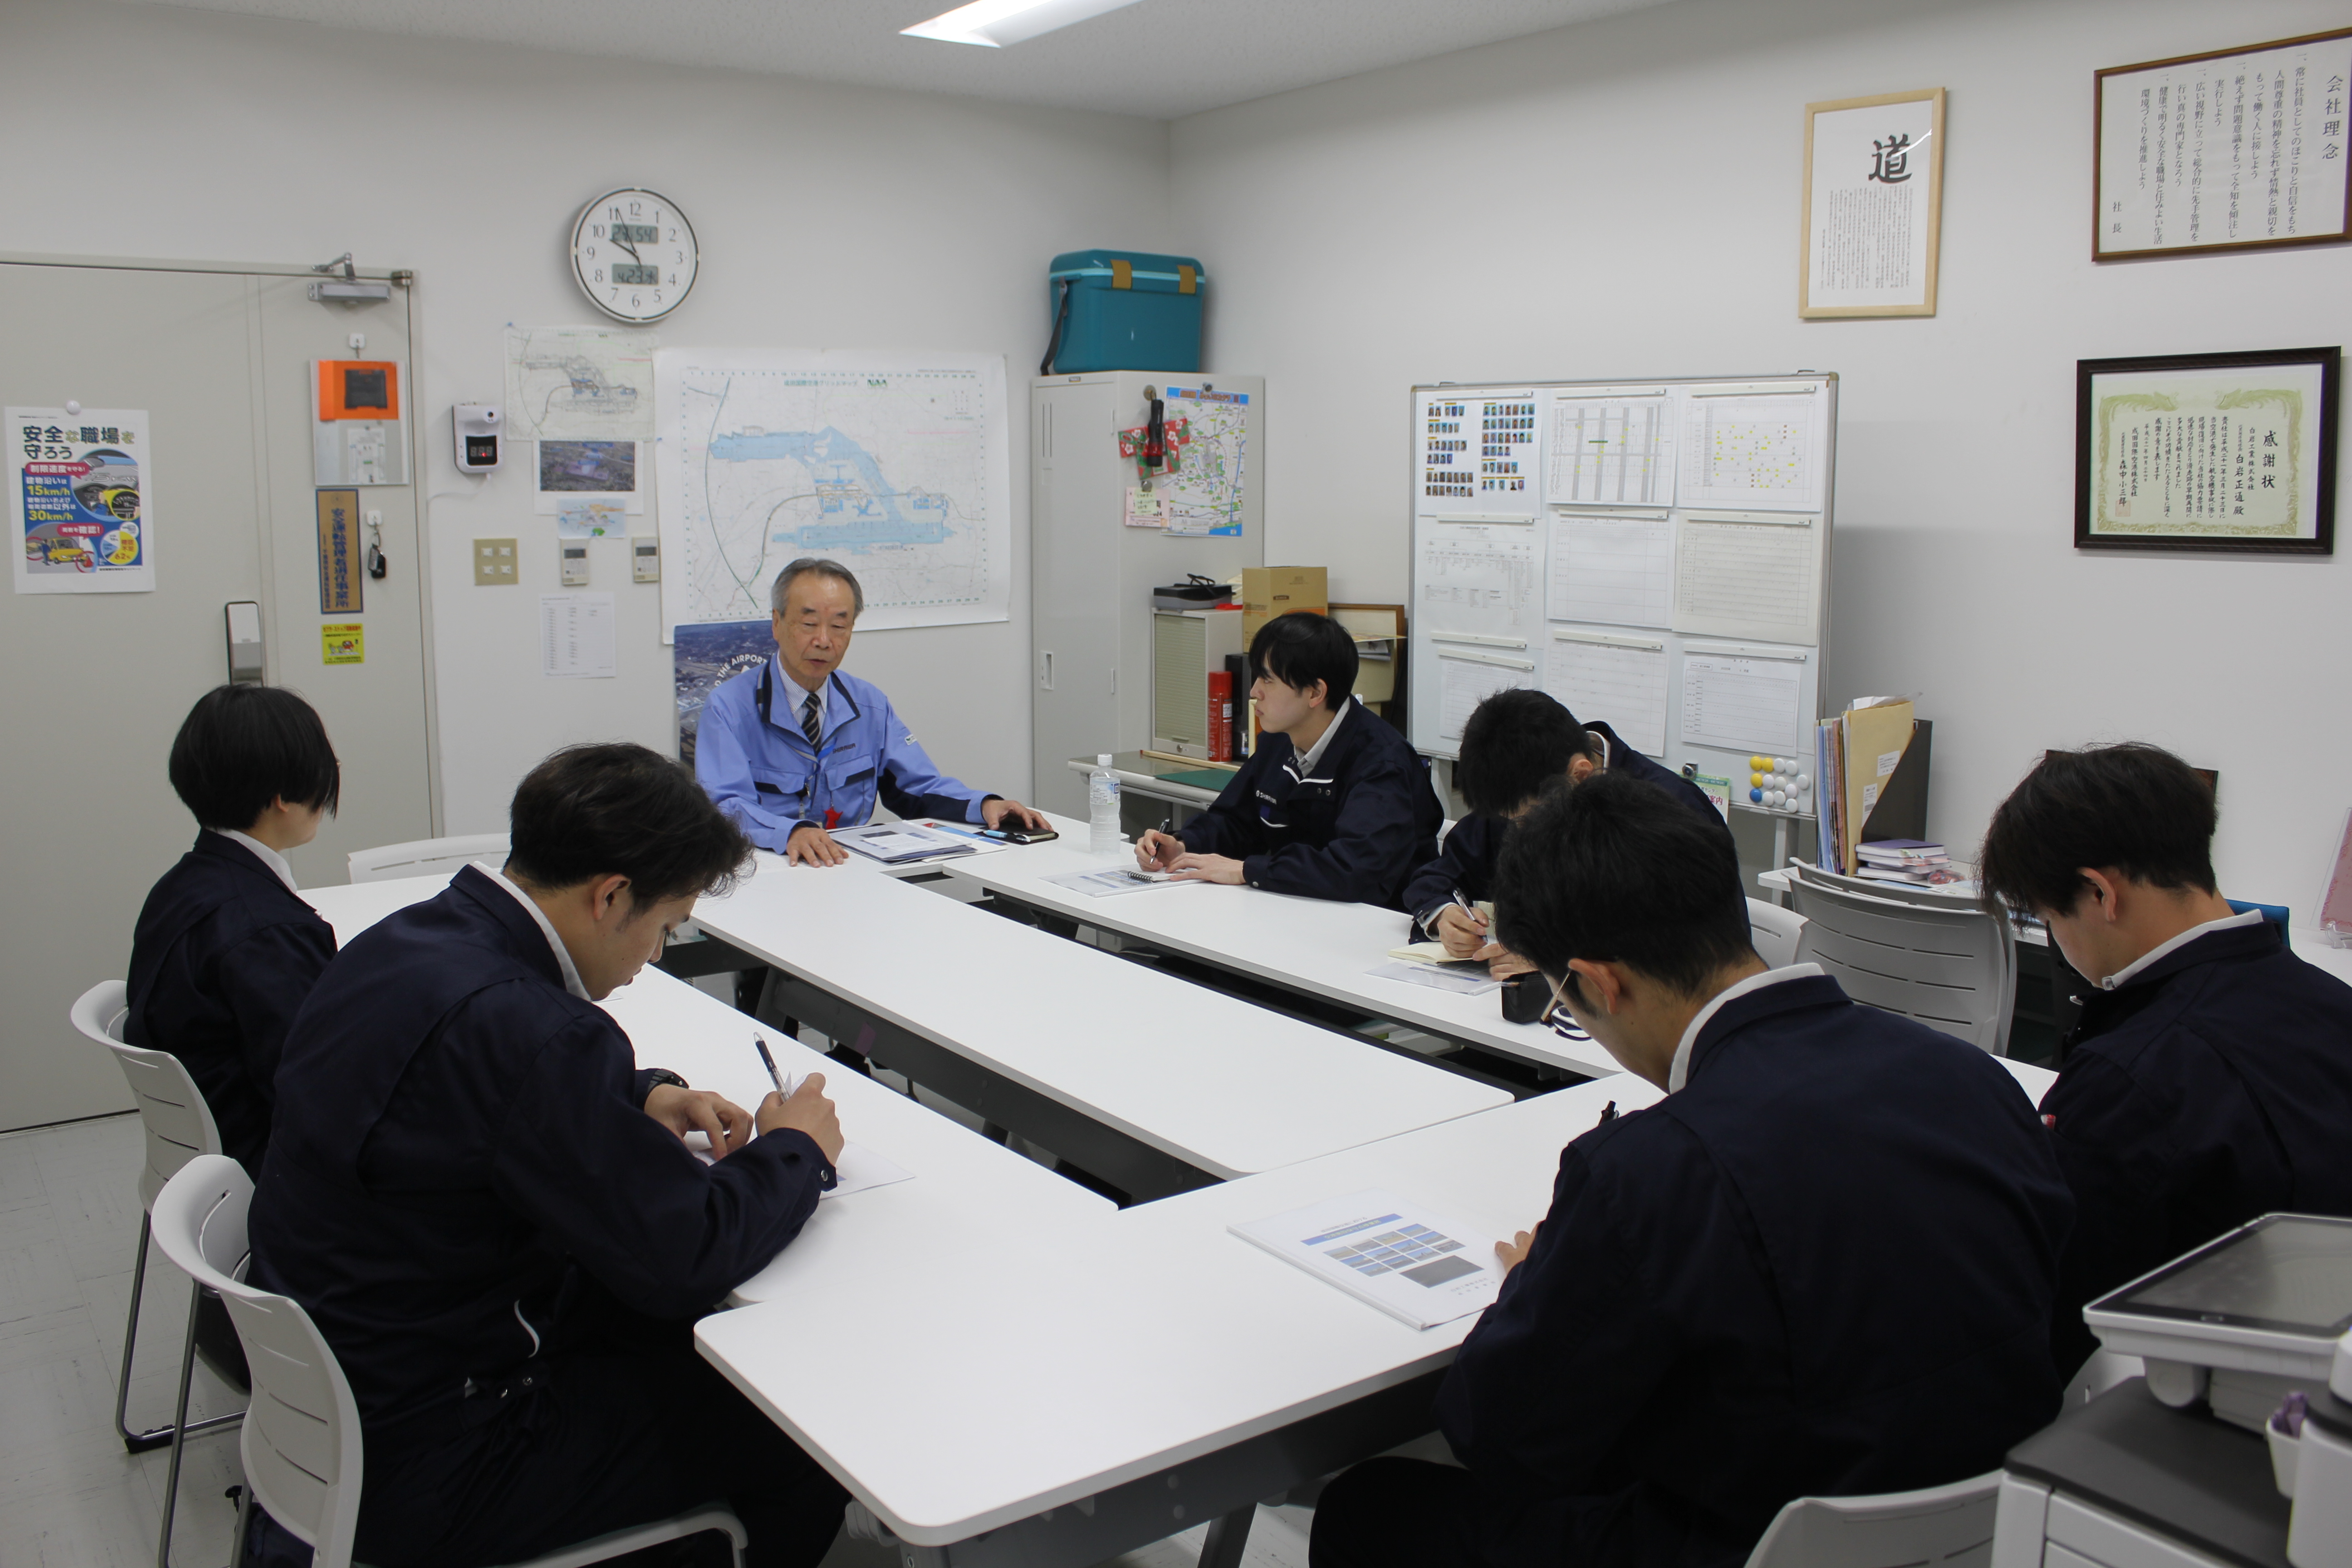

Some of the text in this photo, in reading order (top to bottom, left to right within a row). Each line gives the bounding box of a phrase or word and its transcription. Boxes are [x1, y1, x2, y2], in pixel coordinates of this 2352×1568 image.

[2214, 79, 2225, 127] 実行しよう
[2322, 75, 2343, 160] 会社理念
[2250, 73, 2264, 179] もって働く人に接しよう
[2138, 89, 2150, 190] 環境づくりを推進しよう
[2175, 85, 2186, 187] 行い真の専門家となろう
[1868, 133, 1912, 184] 道
[2267, 69, 2285, 235] 人間尊重の精神を忘れず情熱と親切を
[609, 206, 619, 220] 11
[630, 203, 641, 216] 12
[655, 211, 659, 224] 1
[2112, 201, 2122, 234] 社長
[593, 224, 605, 238] 10
[668, 228, 676, 242] 2
[587, 246, 595, 260] 9
[676, 250, 683, 265] 3
[594, 269, 603, 283] 8
[668, 273, 676, 286] 4
[611, 287, 618, 301] 7
[632, 293, 640, 308] 6
[653, 289, 661, 303] 5
[23, 426, 135, 445] 安全な職場を
[24, 444, 73, 460] 守ろう
[2154, 417, 2162, 481] 感謝の意を表します
[2261, 430, 2278, 489] 感謝状
[27, 485, 70, 495] 15km/h
[2119, 459, 2127, 507] 森中小三郎
[2233, 454, 2244, 515] 白岩正通殿
[29, 510, 74, 521] 30km/h
[717, 662, 731, 679] THE
[731, 654, 767, 666] AIRPORT
[1708, 795, 1723, 806] 案内
